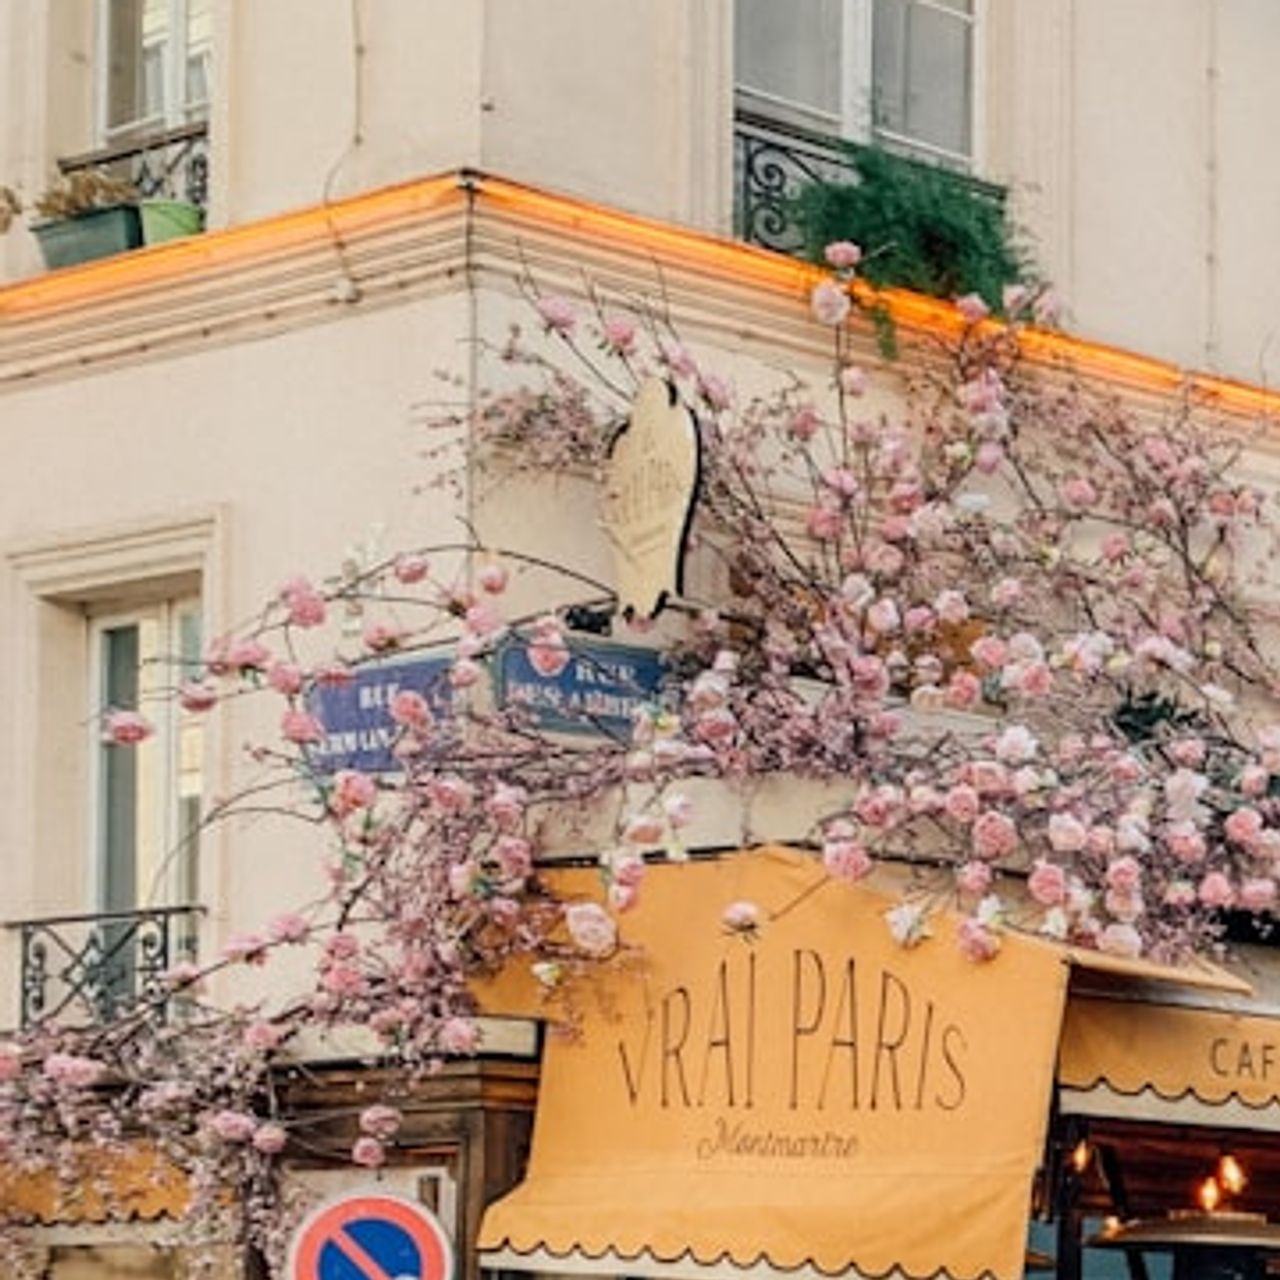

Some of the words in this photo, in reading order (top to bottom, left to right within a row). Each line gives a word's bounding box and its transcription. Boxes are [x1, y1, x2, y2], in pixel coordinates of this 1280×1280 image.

[617, 948, 757, 1110] VRAI
[788, 948, 969, 1112] PARIS
[696, 1115, 860, 1160] Montmartre
